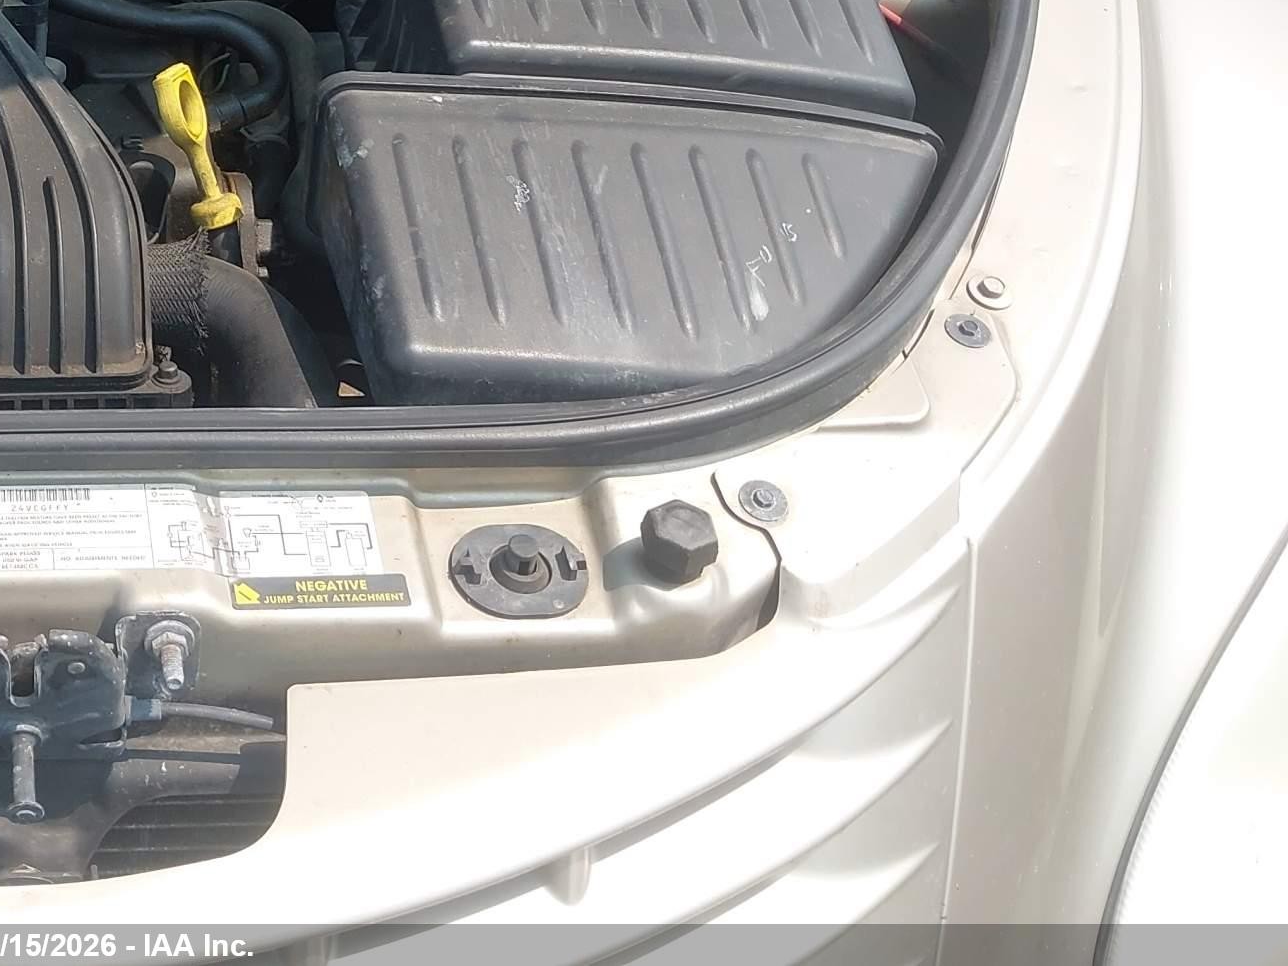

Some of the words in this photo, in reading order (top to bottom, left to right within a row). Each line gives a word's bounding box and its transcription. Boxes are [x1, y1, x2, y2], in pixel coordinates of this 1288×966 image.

[295, 579, 368, 592] NEGATIVE
[263, 594, 294, 604] JUMP
[297, 593, 329, 603] START
[332, 592, 405, 603] ATTACHMENT
